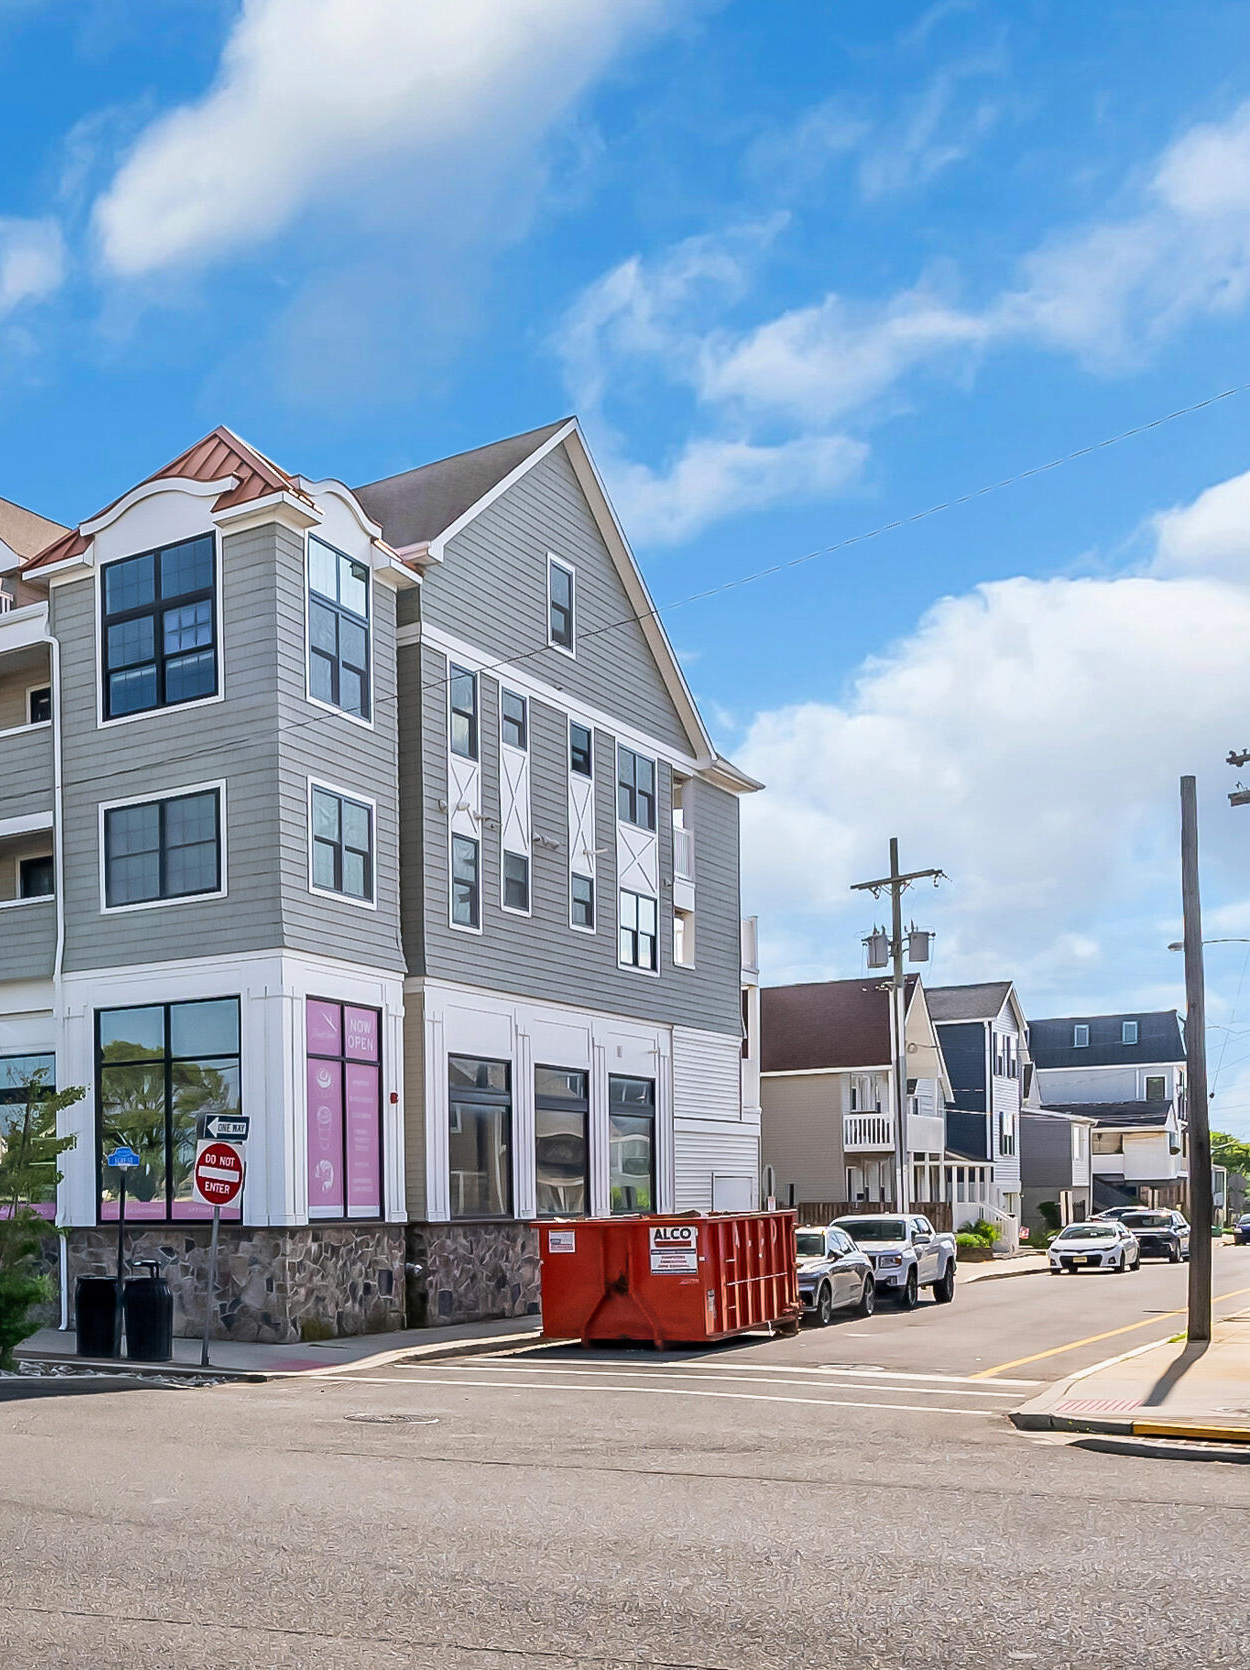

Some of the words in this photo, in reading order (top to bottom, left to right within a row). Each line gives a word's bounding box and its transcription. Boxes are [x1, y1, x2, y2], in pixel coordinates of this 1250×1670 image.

[350, 1018, 372, 1034] NOW
[347, 1034, 374, 1052] OPEN
[218, 1123, 230, 1133] ONE
[232, 1123, 245, 1133] WAY
[205, 1153, 217, 1165] DO
[219, 1156, 236, 1168] NOT
[204, 1181, 231, 1195] ENTER
[654, 1227, 692, 1240] ALCO
